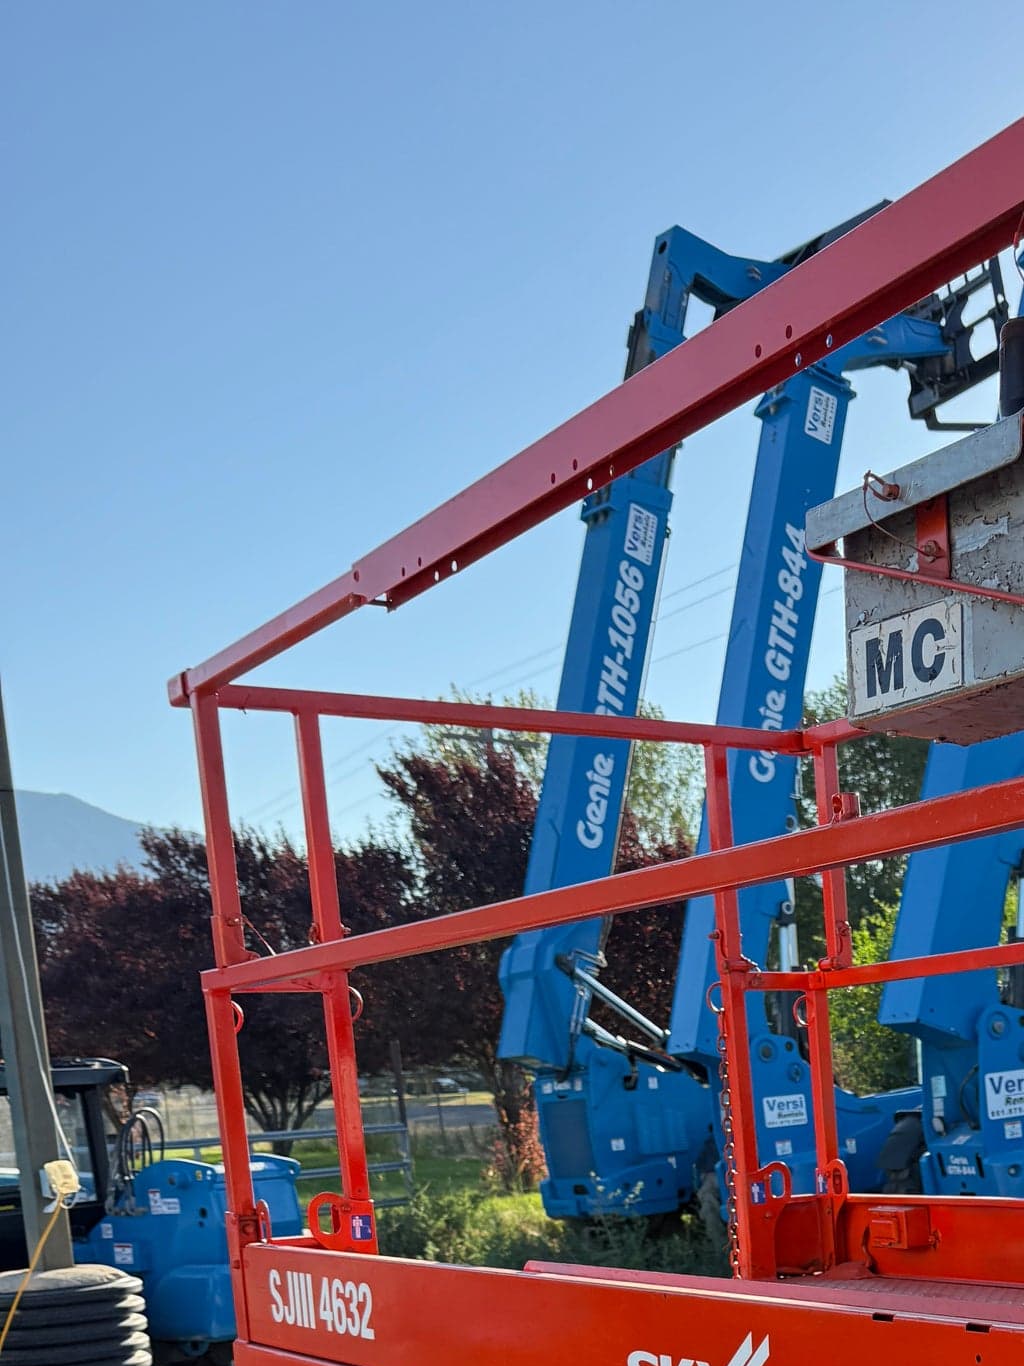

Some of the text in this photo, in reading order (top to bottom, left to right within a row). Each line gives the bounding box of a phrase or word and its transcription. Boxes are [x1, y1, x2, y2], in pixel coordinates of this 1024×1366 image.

[765, 522, 807, 681] GTH-844
[865, 618, 946, 698] MC
[577, 753, 615, 849] Genie
[765, 1096, 804, 1112] Versi
[269, 1268, 375, 1340] SJIII 4632
